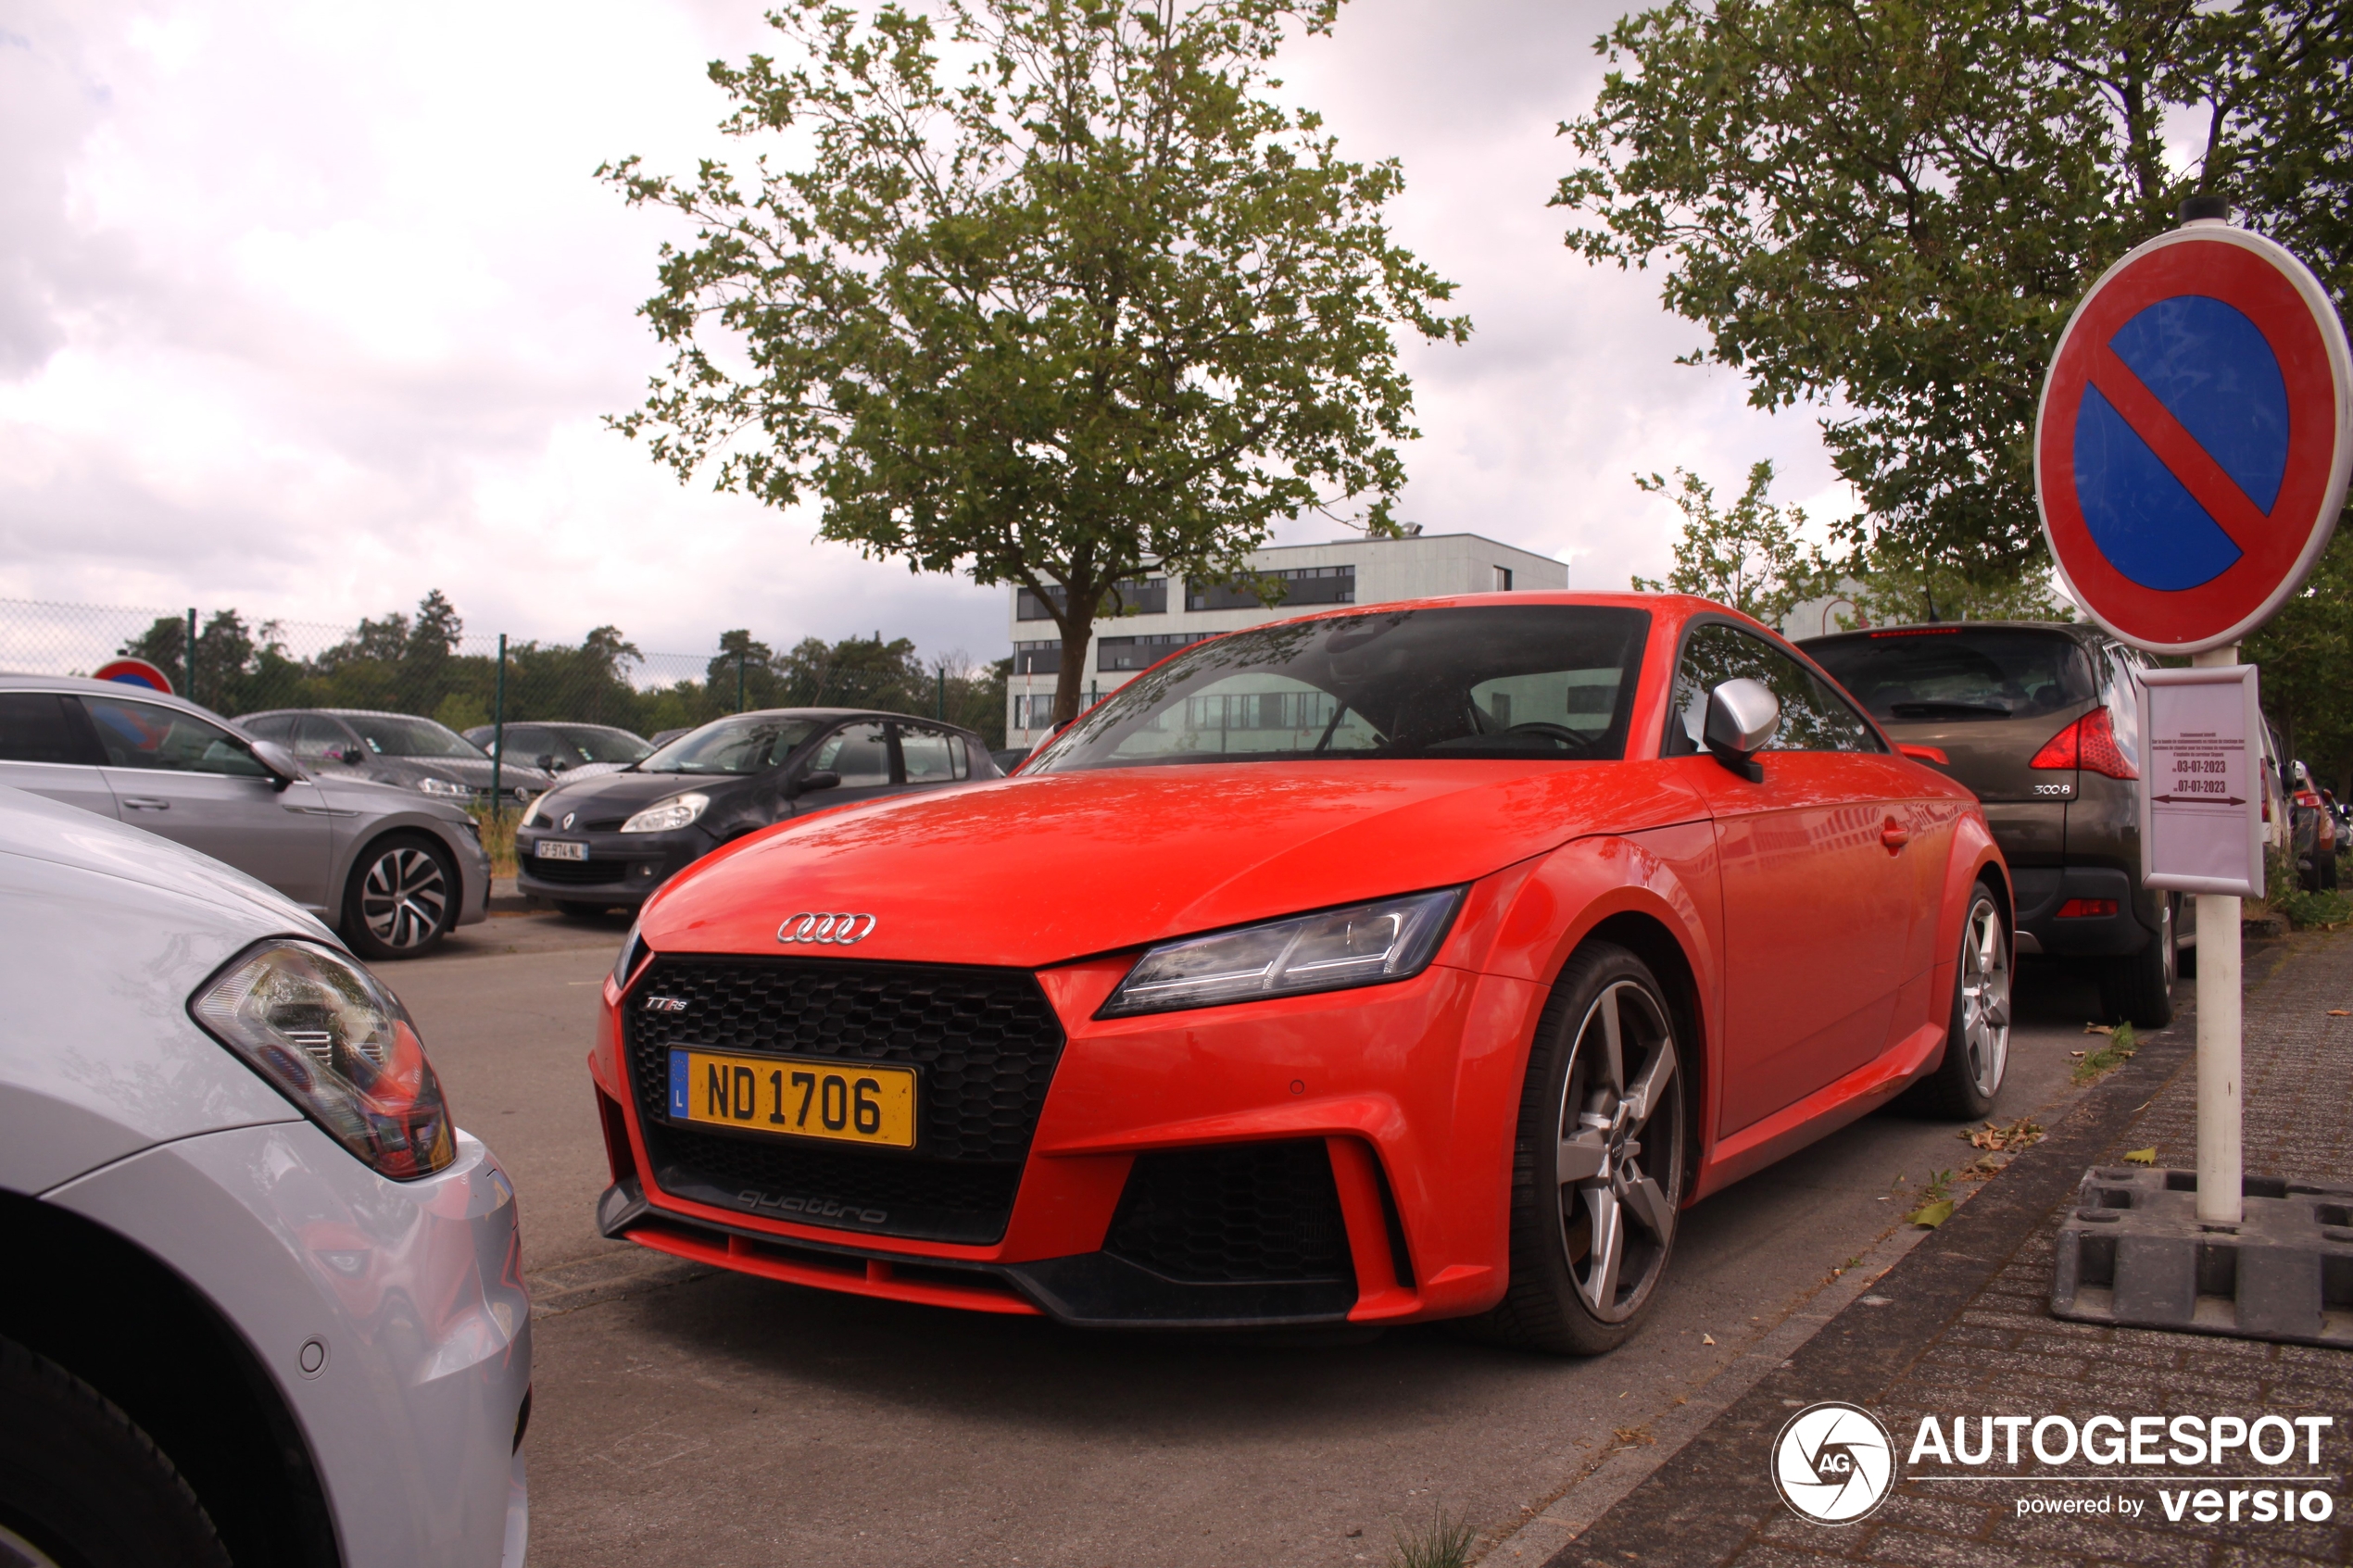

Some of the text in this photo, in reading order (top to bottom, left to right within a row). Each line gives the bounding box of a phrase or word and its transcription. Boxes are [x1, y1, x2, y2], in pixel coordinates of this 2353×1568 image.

[2177, 760, 2226, 773] 03-07-2023
[2032, 784, 2070, 795] 3008
[2178, 780, 2225, 793] 07-07-2023
[675, 1089, 683, 1108] L
[708, 1062, 882, 1135] ND 1706
[737, 1189, 887, 1224] quattro
